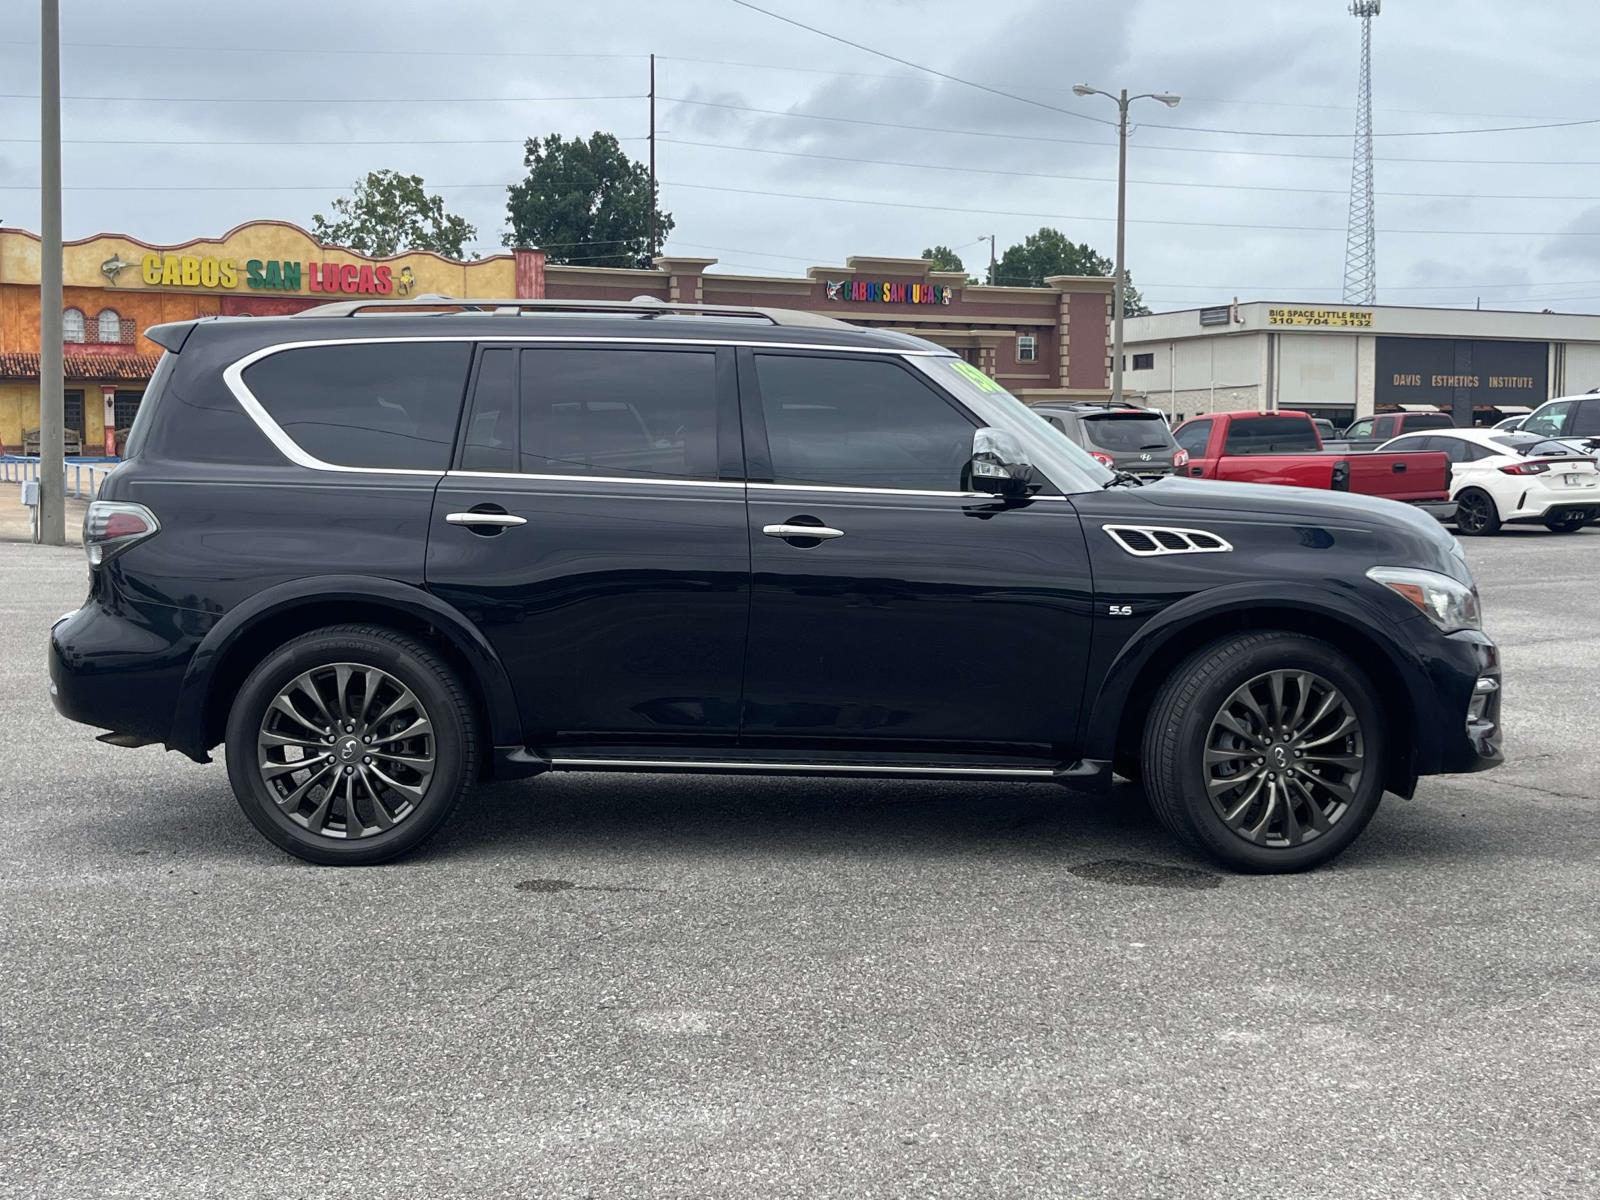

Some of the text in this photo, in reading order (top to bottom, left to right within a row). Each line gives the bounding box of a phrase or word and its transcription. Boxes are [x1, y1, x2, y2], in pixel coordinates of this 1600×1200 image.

[143, 254, 393, 293] CABOS SAN LUCAS
[844, 280, 943, 305] CABOS SAN LUCAS
[1269, 309, 1372, 320] BIG SPACE LITTLE RENT
[1270, 317, 1294, 325] 310
[1306, 318, 1329, 326] 704
[1341, 319, 1372, 327] 3132
[1393, 374, 1534, 389] DAVIS ESTHETICS INSTITUTE
[1109, 605, 1132, 615] 5.6
